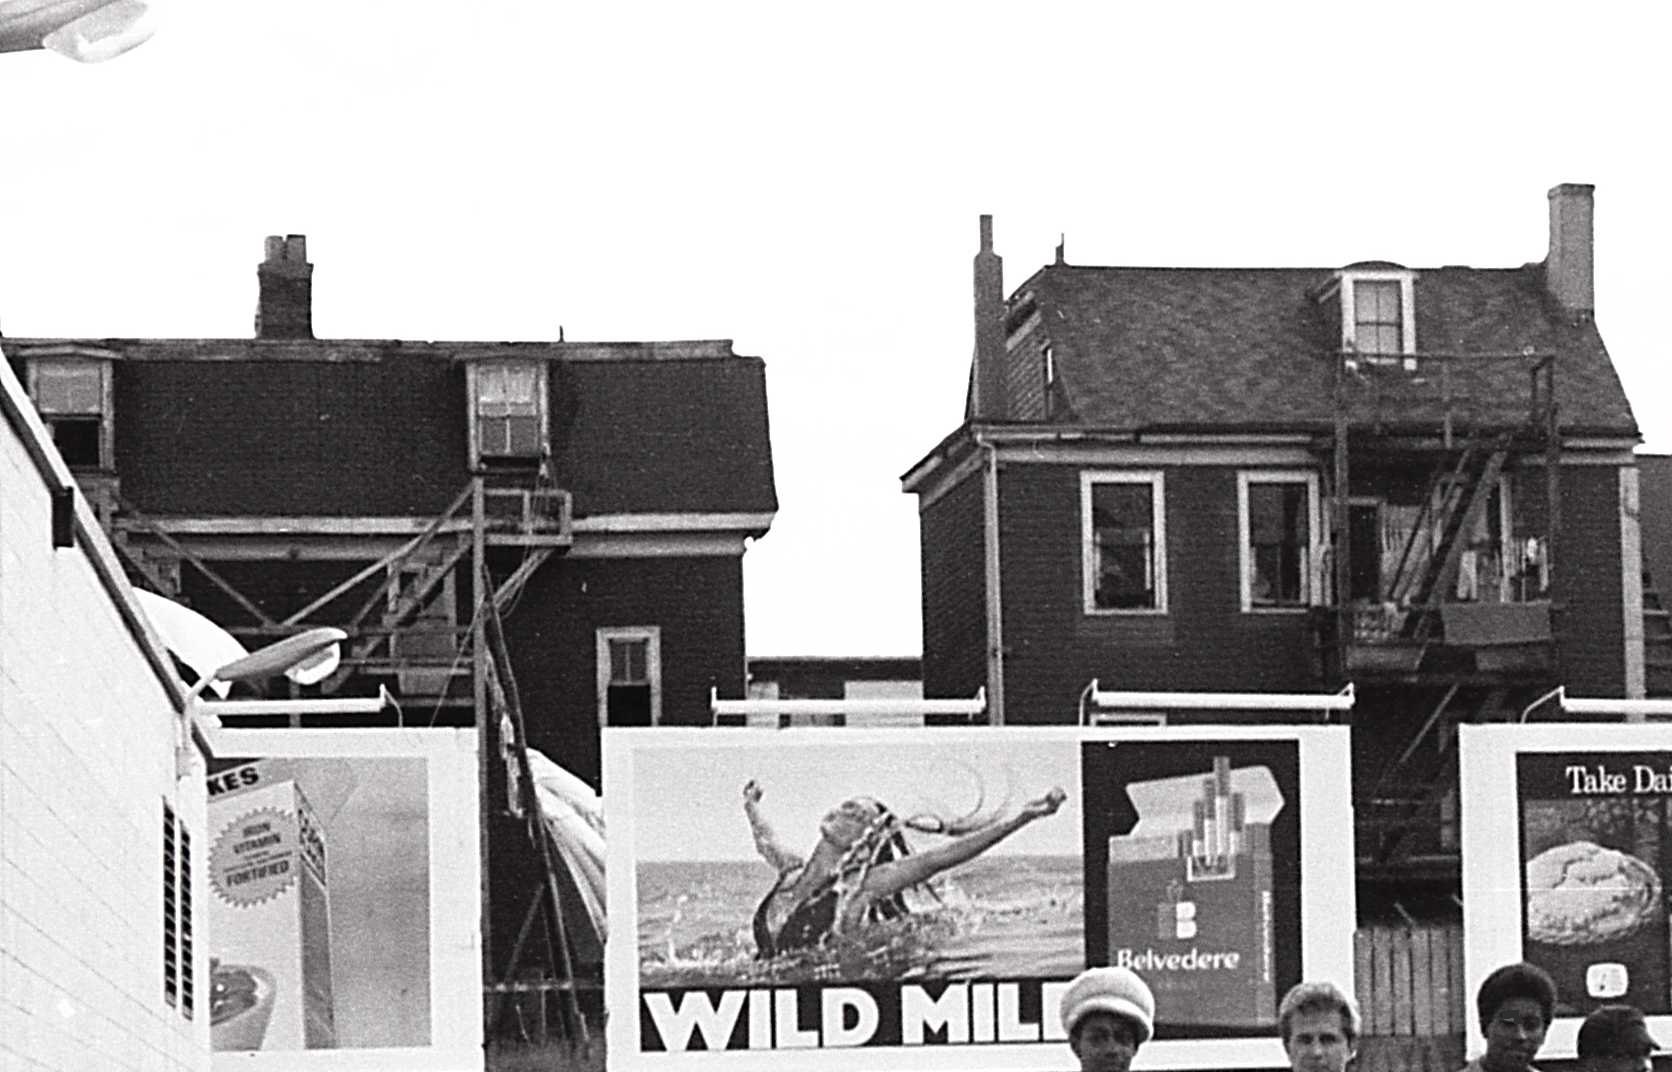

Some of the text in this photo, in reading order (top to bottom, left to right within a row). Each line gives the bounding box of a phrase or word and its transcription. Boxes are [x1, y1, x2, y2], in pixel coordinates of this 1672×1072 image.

[1566, 765, 1627, 794] Take
[227, 860, 289, 887] FORTIFIED
[1117, 947, 1241, 971] Belvedere
[643, 987, 879, 1051] WILD
